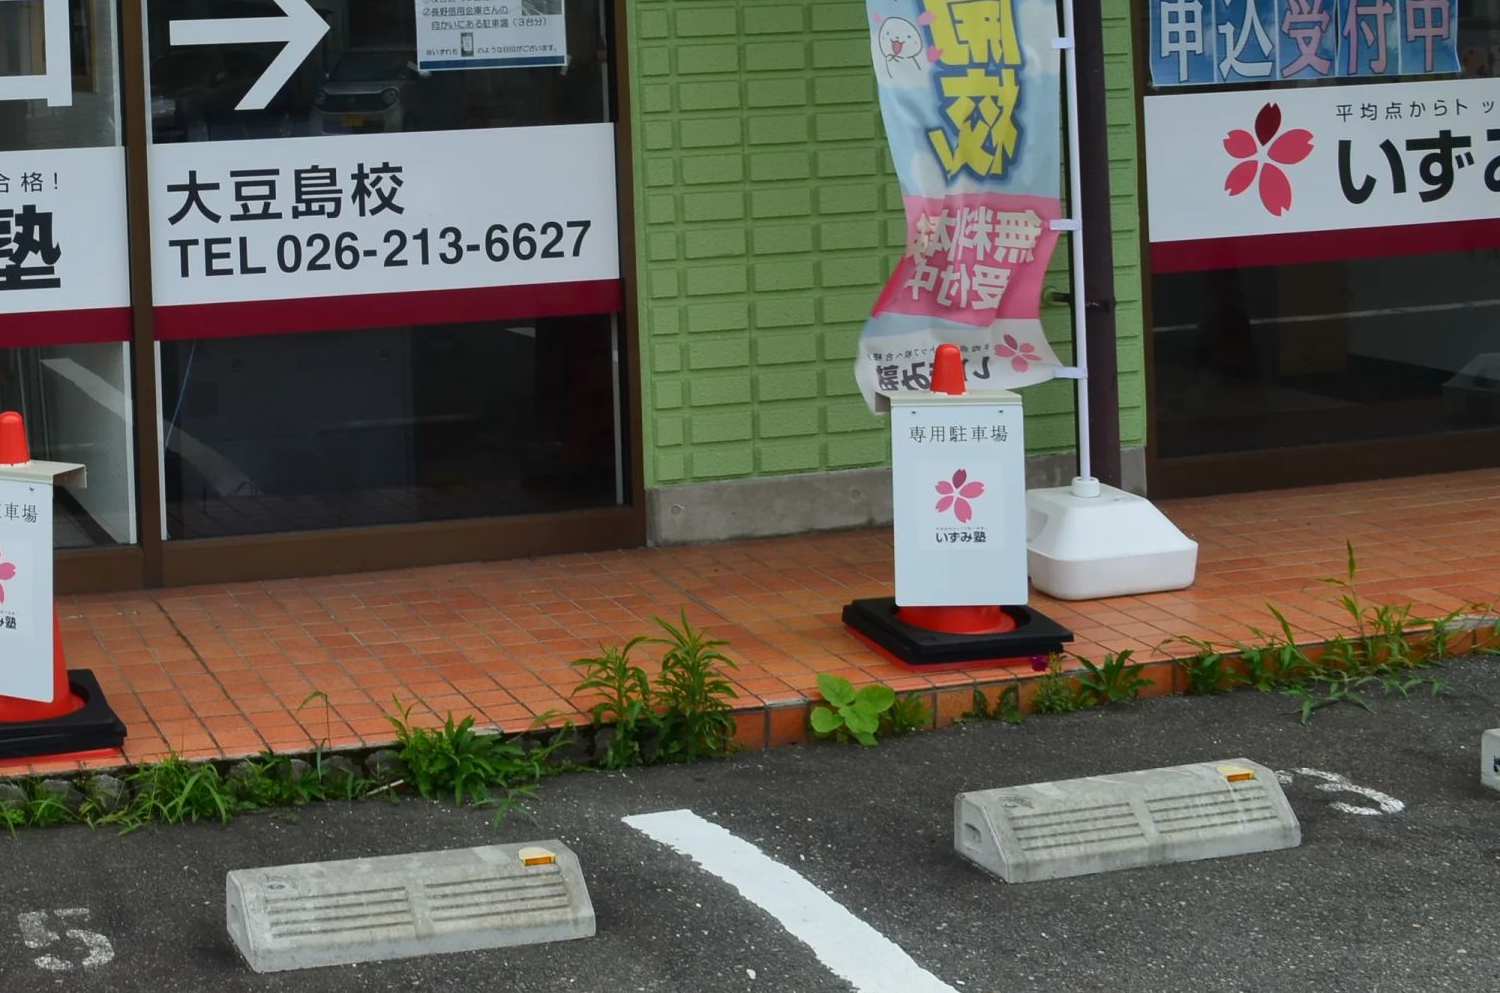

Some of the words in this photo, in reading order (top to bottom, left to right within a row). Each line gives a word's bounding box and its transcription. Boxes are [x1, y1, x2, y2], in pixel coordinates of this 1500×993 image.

[166, 162, 405, 226] 大豆島校
[1338, 129, 1500, 205] いず
[908, 423, 1008, 444] 専用駐車場
[936, 531, 986, 544] いずみ塾
[17, 908, 115, 971] 5
